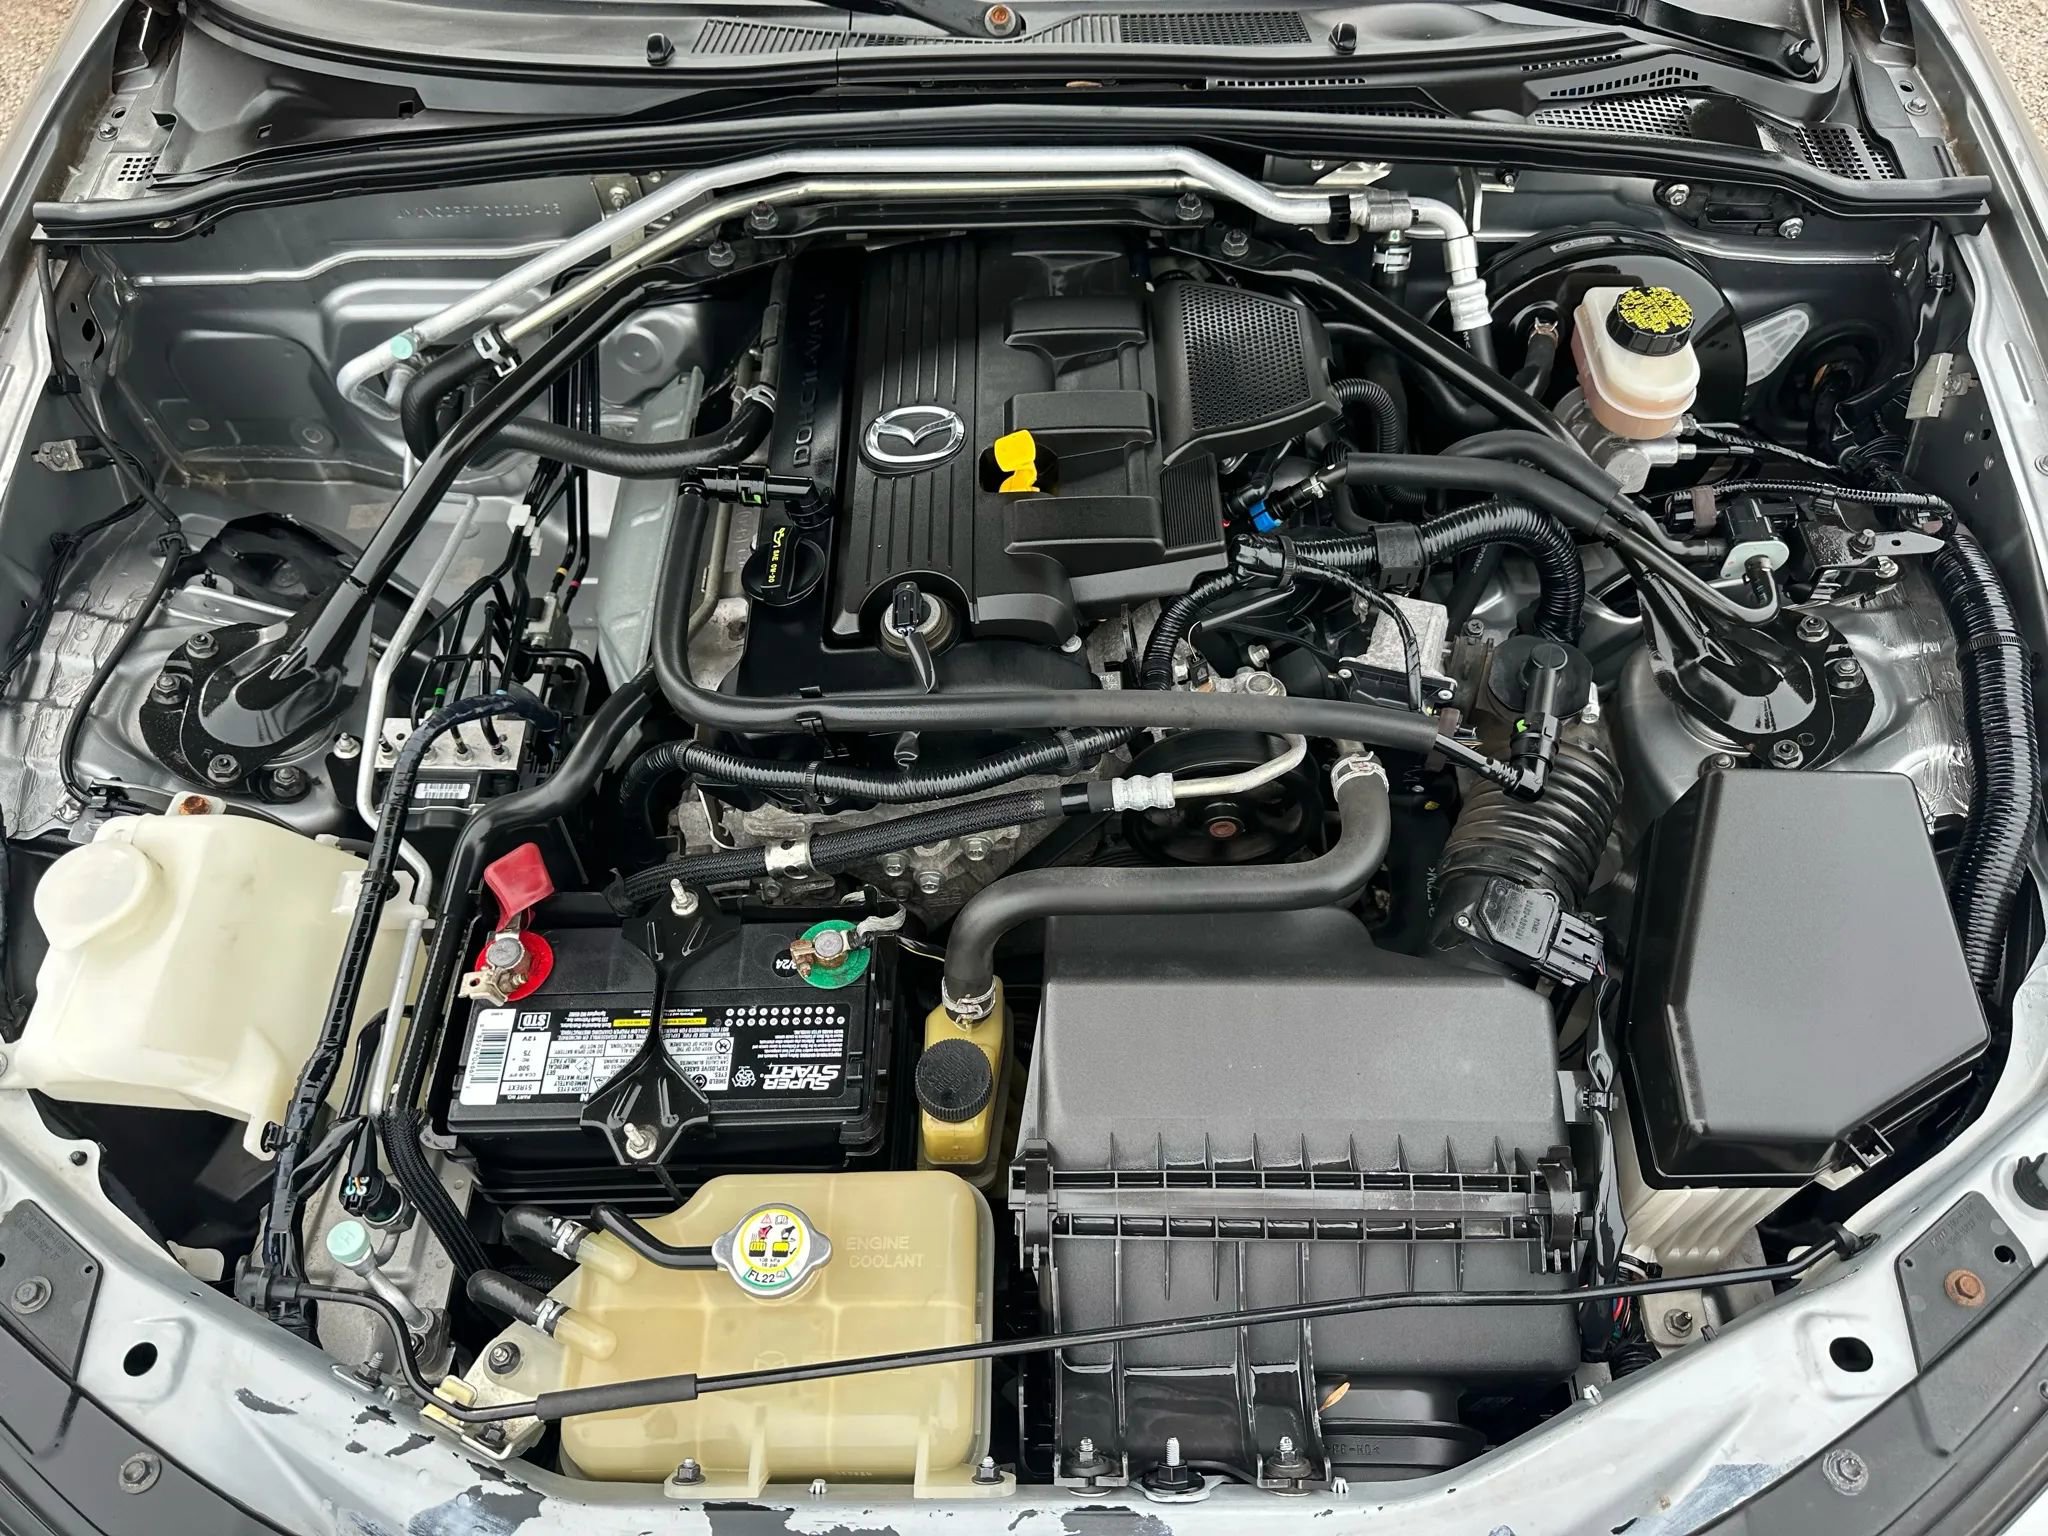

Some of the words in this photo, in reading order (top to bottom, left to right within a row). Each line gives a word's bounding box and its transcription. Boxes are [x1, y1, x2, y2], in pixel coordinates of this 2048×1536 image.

[771, 549, 780, 561] SAE
[522, 1014, 547, 1027] STD
[763, 1064, 841, 1081] START
[762, 1077, 830, 1090] SUPER
[846, 1236, 910, 1251] ENGINE
[849, 1253, 924, 1269] COOLANT
[748, 1269, 775, 1283] FL22
